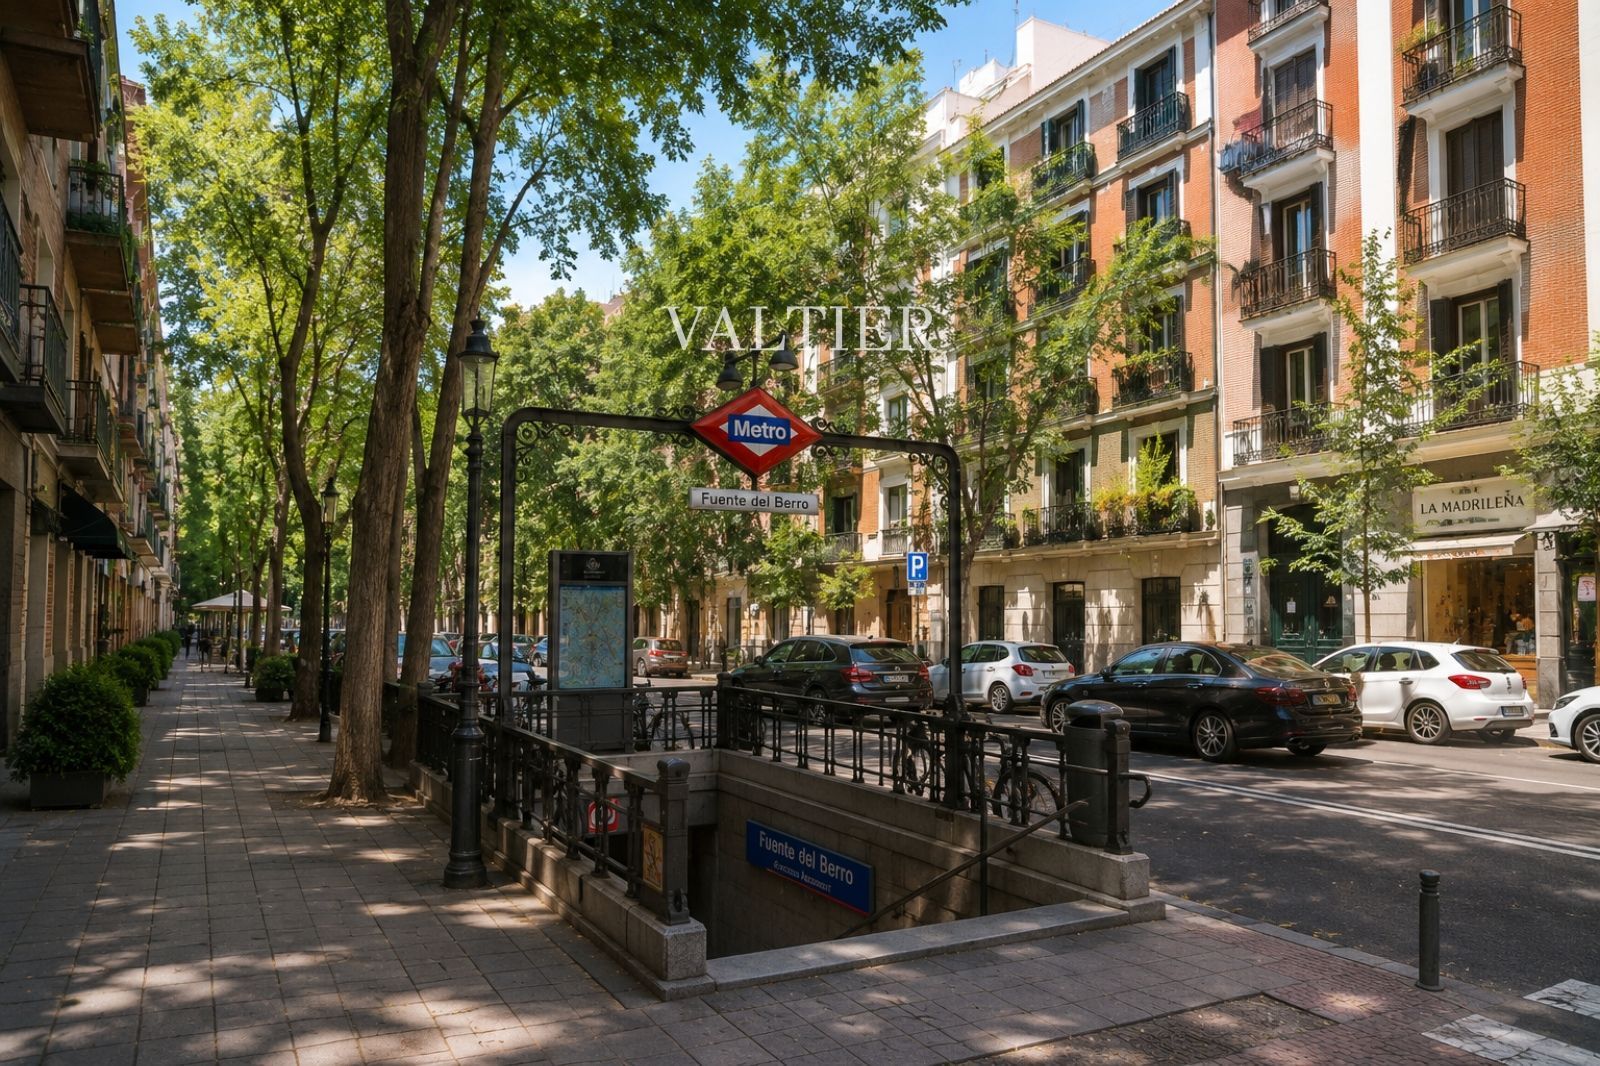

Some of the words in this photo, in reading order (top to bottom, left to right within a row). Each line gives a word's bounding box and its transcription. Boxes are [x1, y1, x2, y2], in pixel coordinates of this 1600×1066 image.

[733, 419, 787, 441] Metro
[701, 492, 747, 507] Fuente
[751, 494, 770, 508] del
[774, 496, 809, 510] Berro
[1420, 503, 1437, 515] LA
[1441, 490, 1525, 513] MADRILEÑA
[911, 555, 924, 578] P
[759, 830, 795, 860] Fuente
[798, 847, 816, 870] del
[820, 854, 854, 886] Berro
